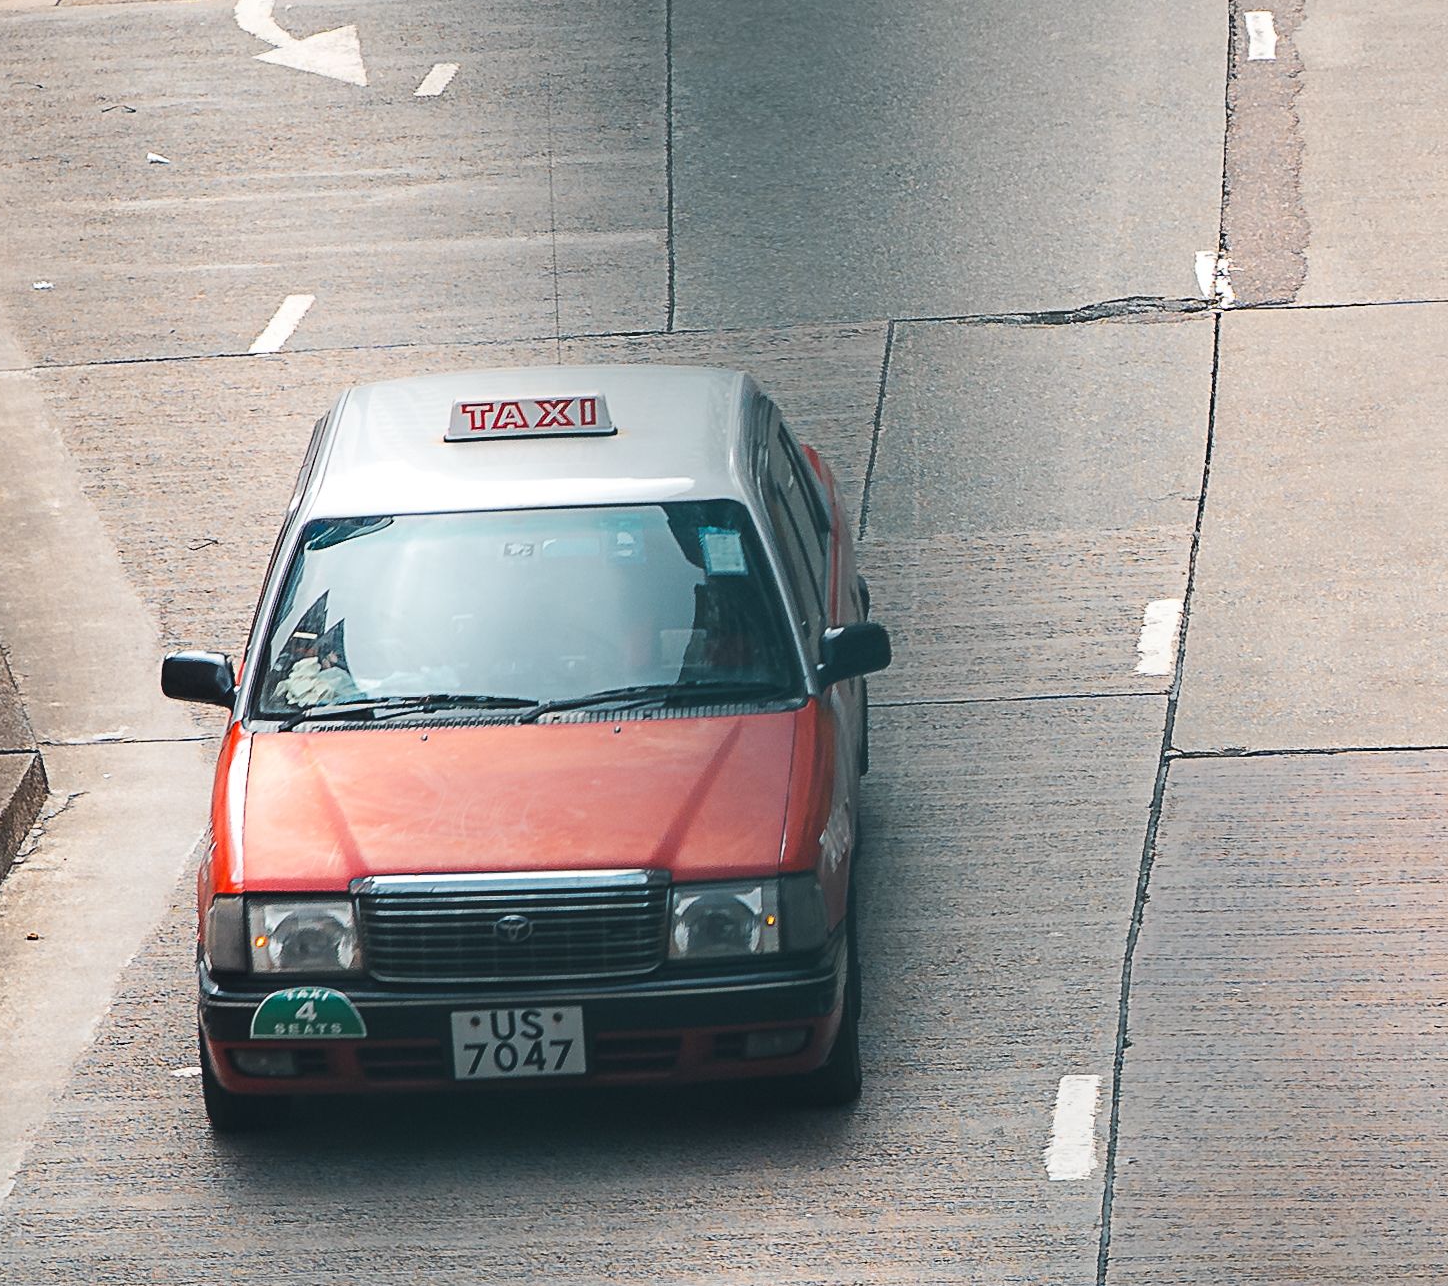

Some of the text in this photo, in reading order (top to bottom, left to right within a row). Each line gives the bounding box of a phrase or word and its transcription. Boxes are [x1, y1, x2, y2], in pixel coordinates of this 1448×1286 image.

[461, 397, 598, 431] TAXI
[295, 1000, 318, 1023] 4
[490, 1010, 545, 1041] US
[274, 1022, 343, 1035] SEATS
[463, 1039, 574, 1076] 7047
